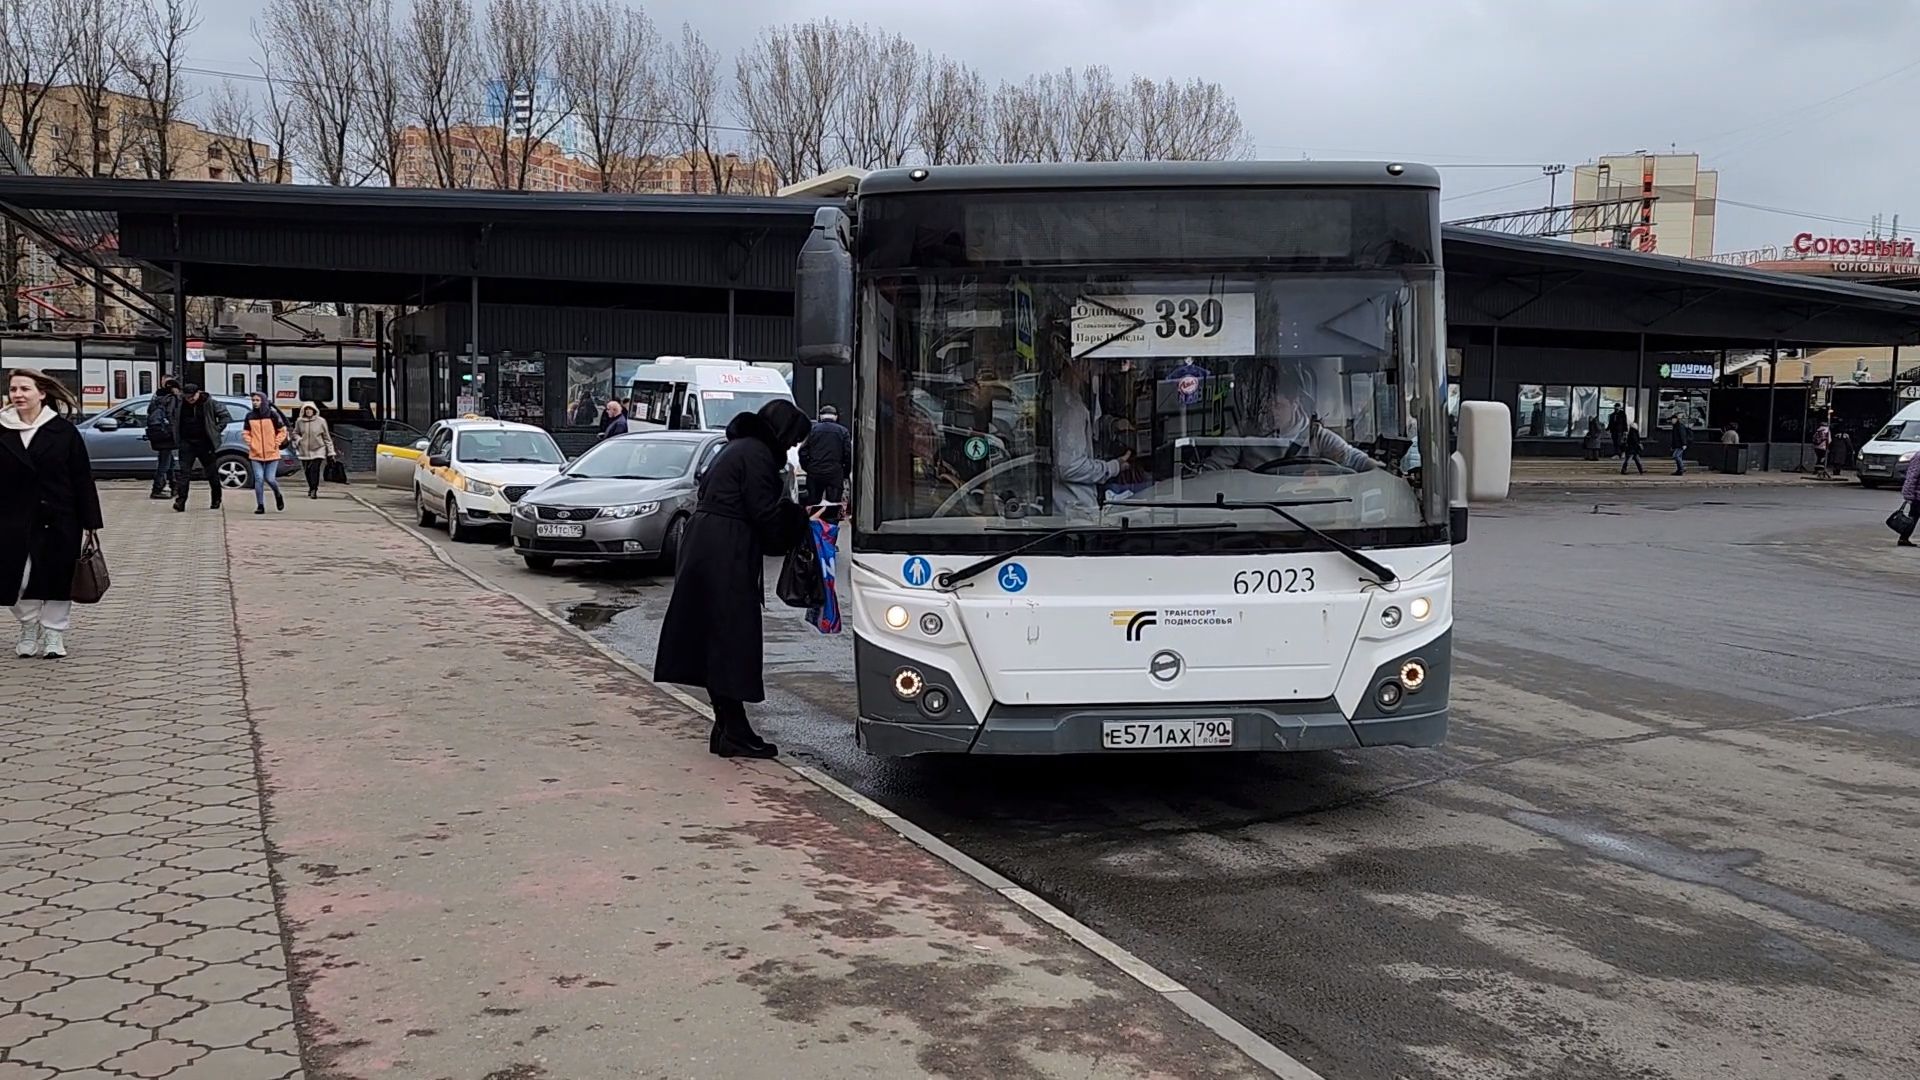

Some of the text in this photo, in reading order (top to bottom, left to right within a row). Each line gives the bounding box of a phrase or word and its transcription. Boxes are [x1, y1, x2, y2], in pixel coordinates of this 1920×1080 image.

[1833, 262, 1890, 272] ТОРГОВЫЙ
[1077, 305, 1144, 317] Одиново
[1155, 298, 1224, 338] 339
[1076, 333, 1145, 344] Парк Пбеды
[1671, 363, 1713, 375] ШАУРМА
[1233, 567, 1315, 595] 62023
[1164, 609, 1216, 617] ТРАНСПОРТ
[1164, 617, 1233, 625] ПОДМОСКОВЬЯ
[1110, 721, 1226, 745] Е571АХ 790
